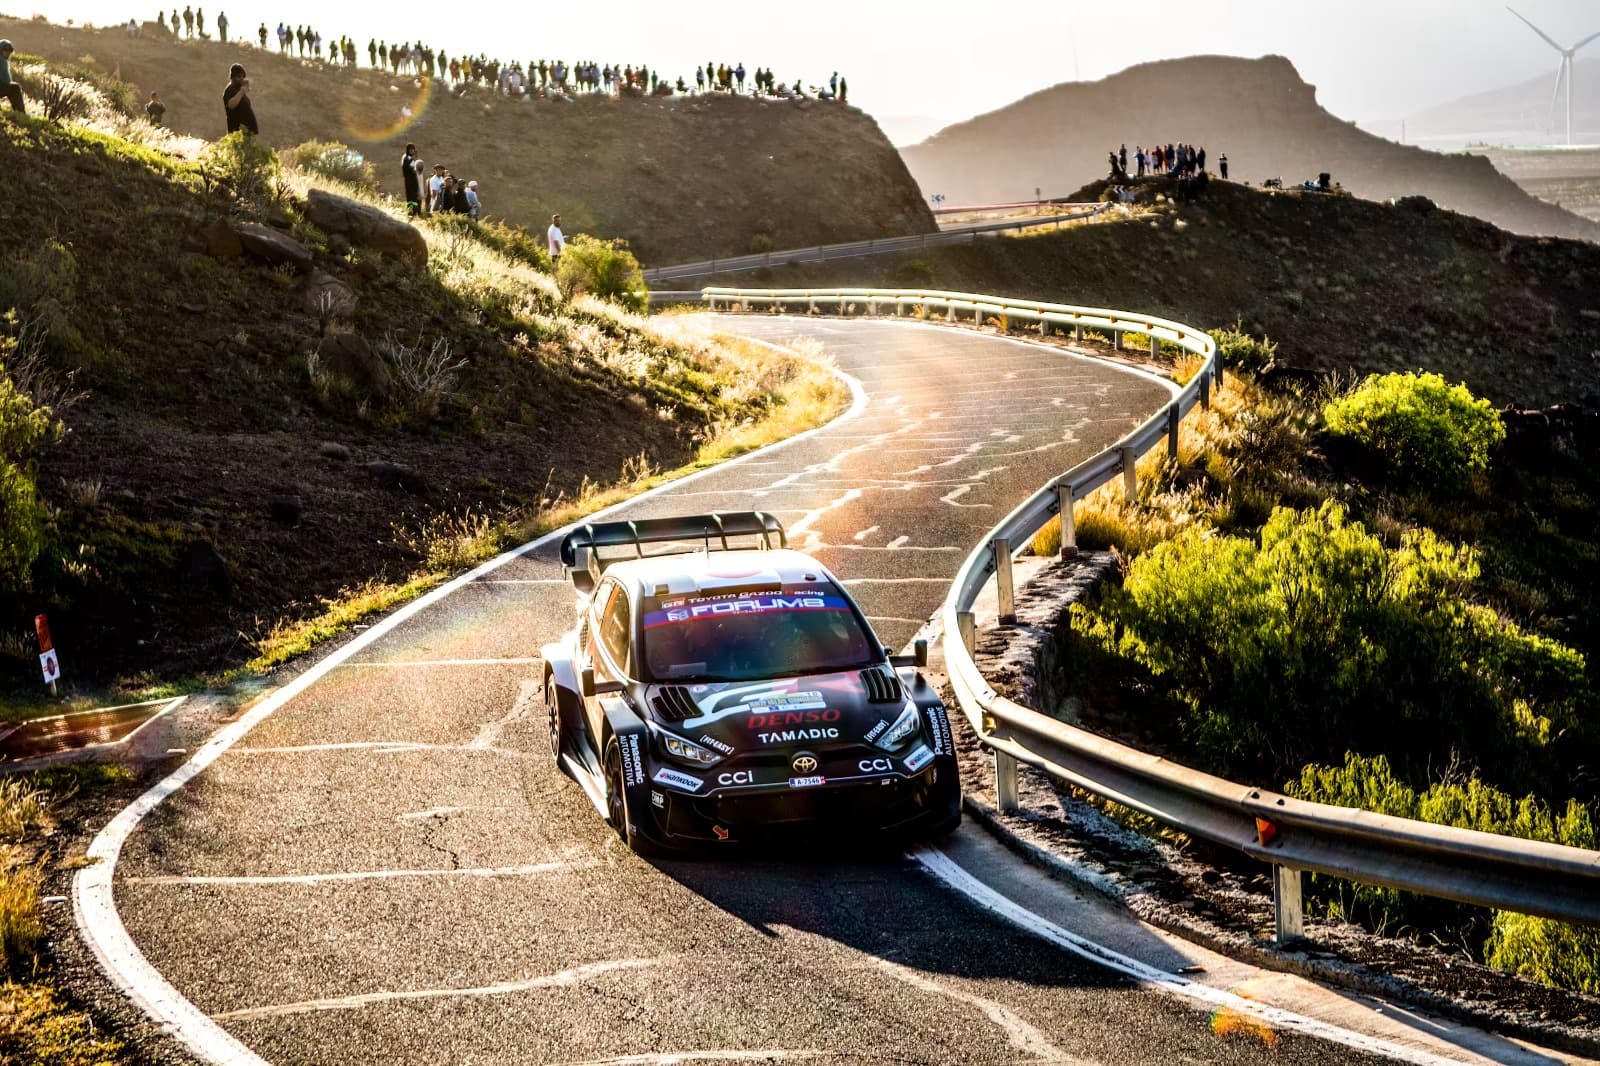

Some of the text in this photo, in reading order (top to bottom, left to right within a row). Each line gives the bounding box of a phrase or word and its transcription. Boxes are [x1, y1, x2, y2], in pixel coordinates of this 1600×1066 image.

[687, 593, 736, 604] TOYOTA
[738, 590, 783, 599] GAZOO
[748, 708, 841, 729] DENSO
[758, 727, 839, 743] TAMADIC
[926, 707, 943, 755] Panasonic
[935, 706, 953, 757] AUTOMOTIVE
[619, 735, 635, 788] AUTOMOTIVE
[629, 733, 646, 784] Panasonic
[858, 759, 894, 772] CCI
[718, 770, 754, 785] CCI
